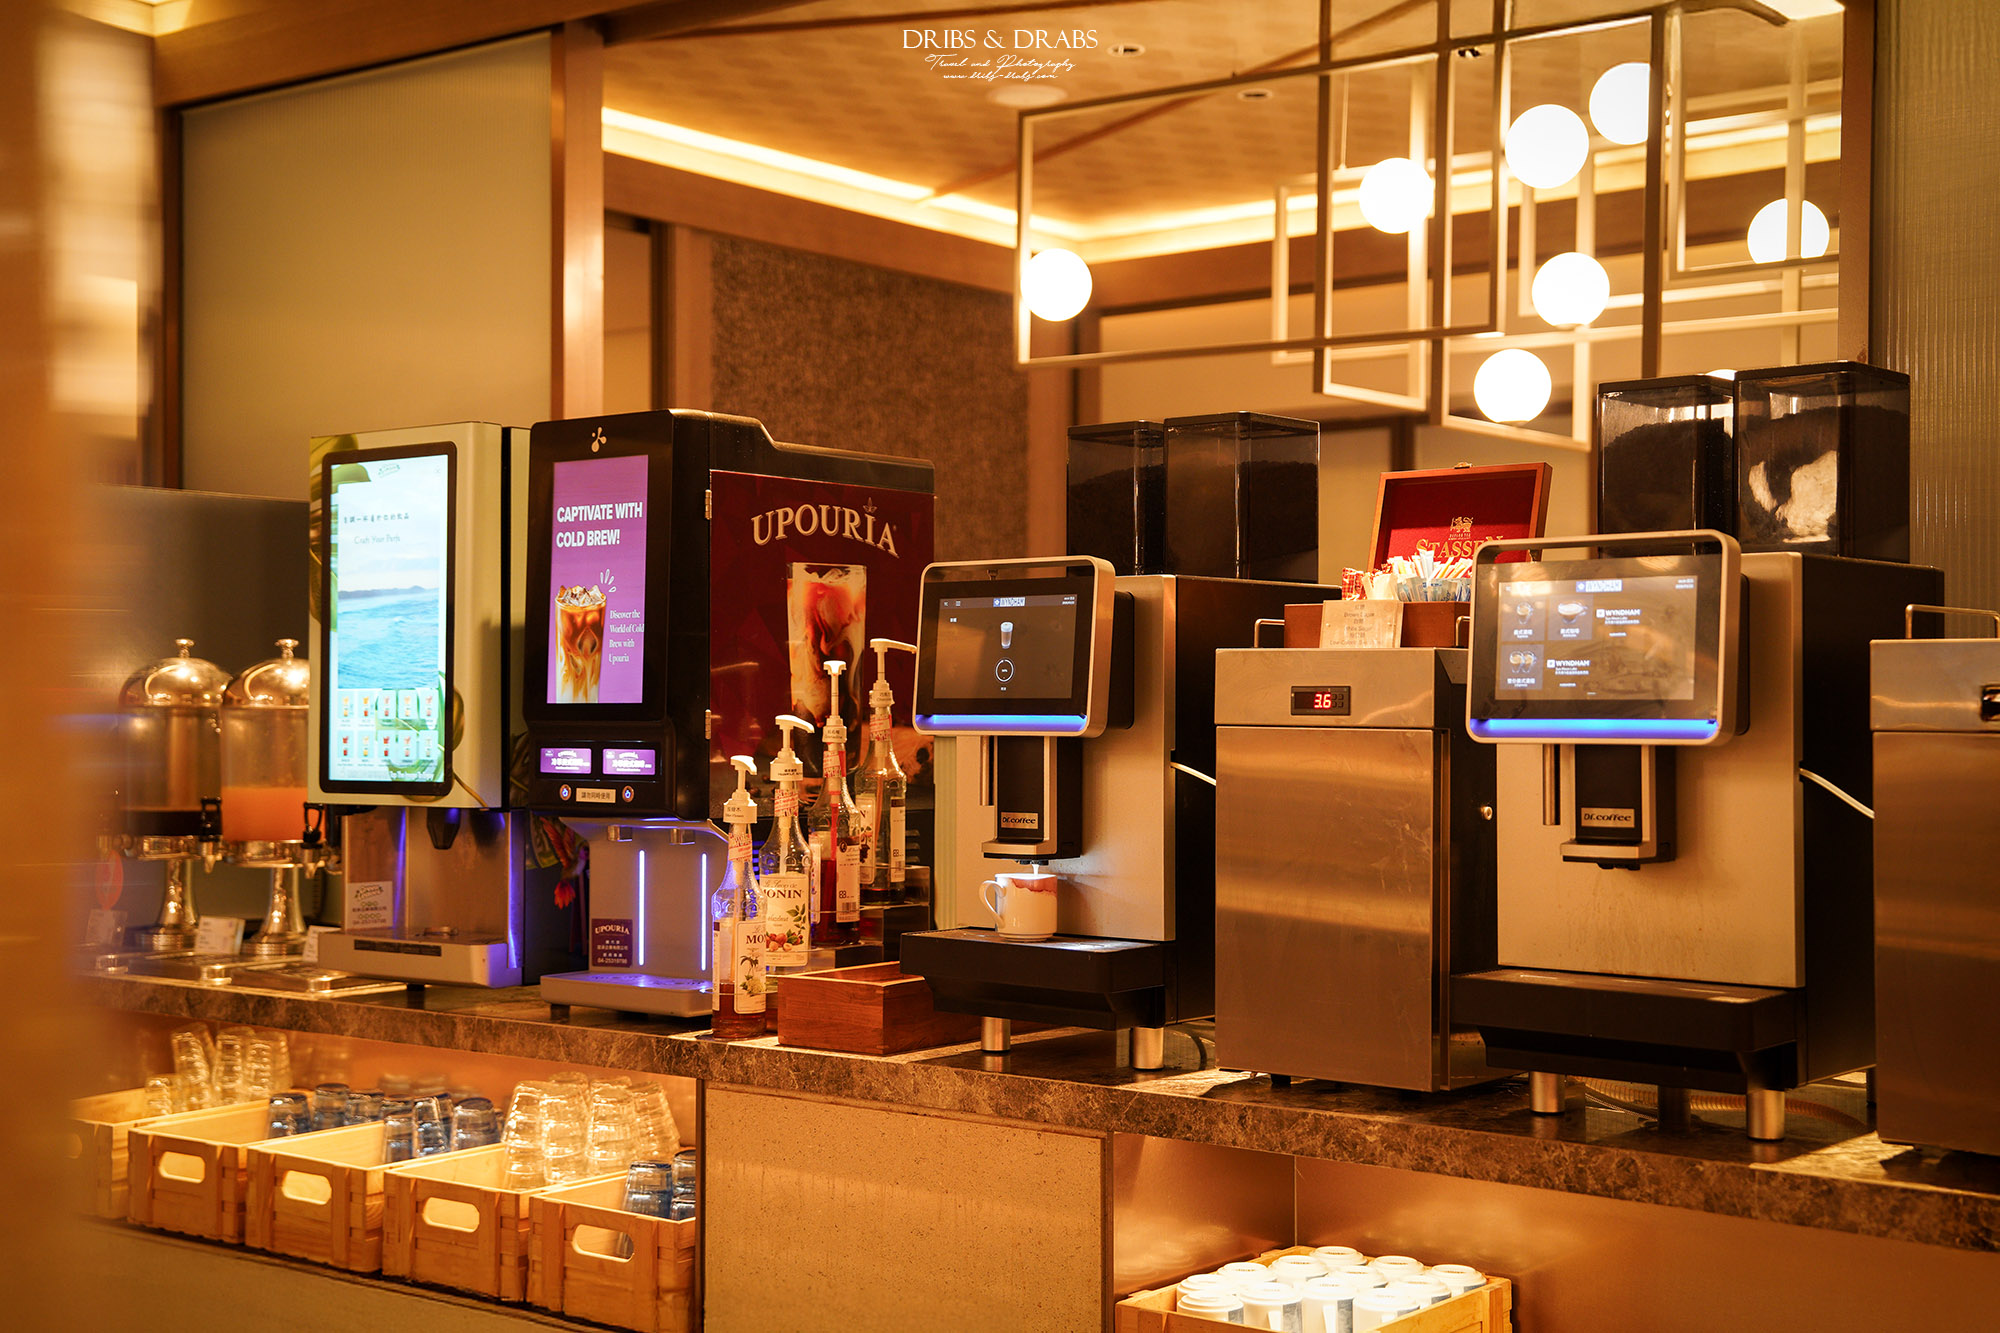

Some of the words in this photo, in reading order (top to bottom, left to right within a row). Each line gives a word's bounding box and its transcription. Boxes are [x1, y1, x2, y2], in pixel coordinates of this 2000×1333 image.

[557, 504, 613, 523] CAPTIVATE
[615, 502, 643, 519] WITH
[750, 503, 900, 558] UPOURIA
[556, 531, 585, 548] COLD
[587, 529, 621, 546] BREW!
[610, 609, 632, 619] Discover
[632, 608, 641, 618] the
[609, 622, 626, 634] World
[632, 620, 645, 633] Cold
[610, 638, 622, 648] Brew
[622, 637, 635, 647] with
[1583, 813, 1632, 821] Dr.coffee
[595, 924, 630, 936] UPOURIA
[746, 934, 767, 945] MO
